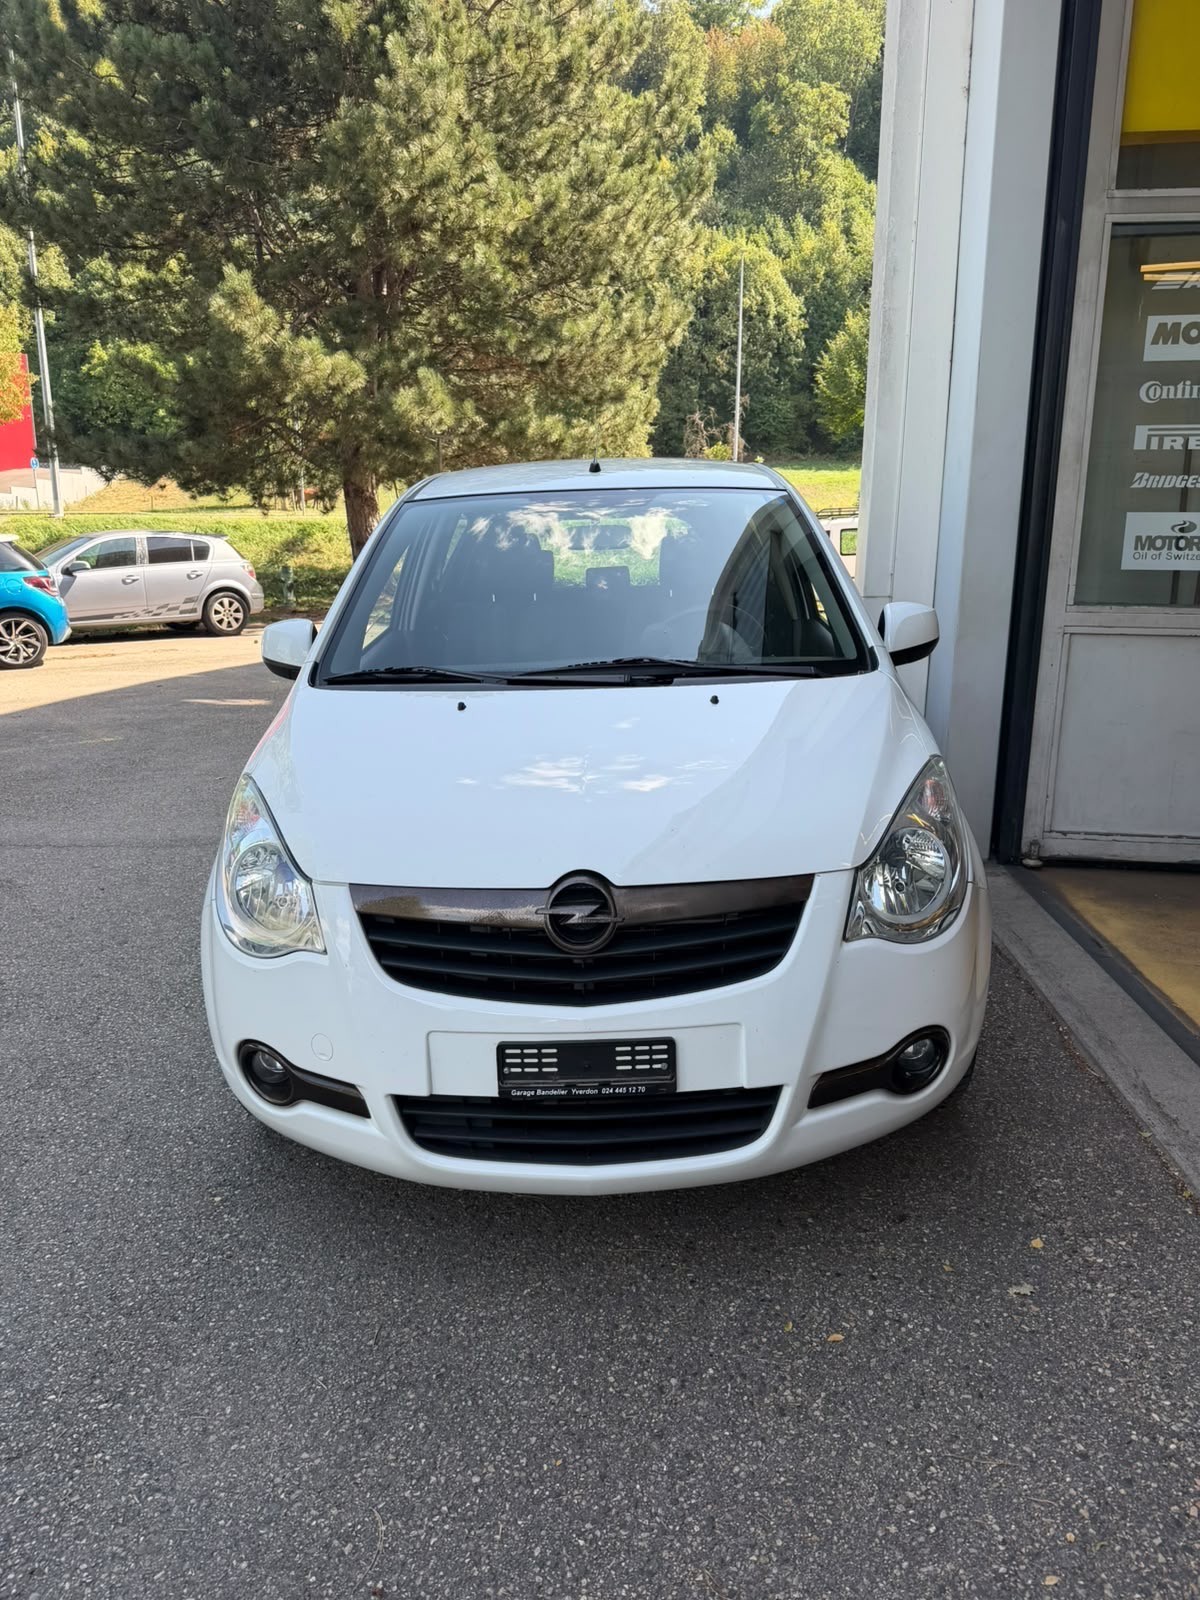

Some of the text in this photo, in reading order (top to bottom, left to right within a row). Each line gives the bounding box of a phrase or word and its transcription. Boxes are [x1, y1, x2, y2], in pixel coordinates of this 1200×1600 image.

[1150, 321, 1200, 345] MO
[1134, 535, 1200, 551] MOTOR
[1133, 552, 1148, 560] Oil
[1151, 552, 1162, 560] of
[511, 1089, 535, 1097] Garage
[536, 1088, 568, 1096] Bandelier
[571, 1087, 599, 1095] Yverdon
[614, 1086, 627, 1094] 445
